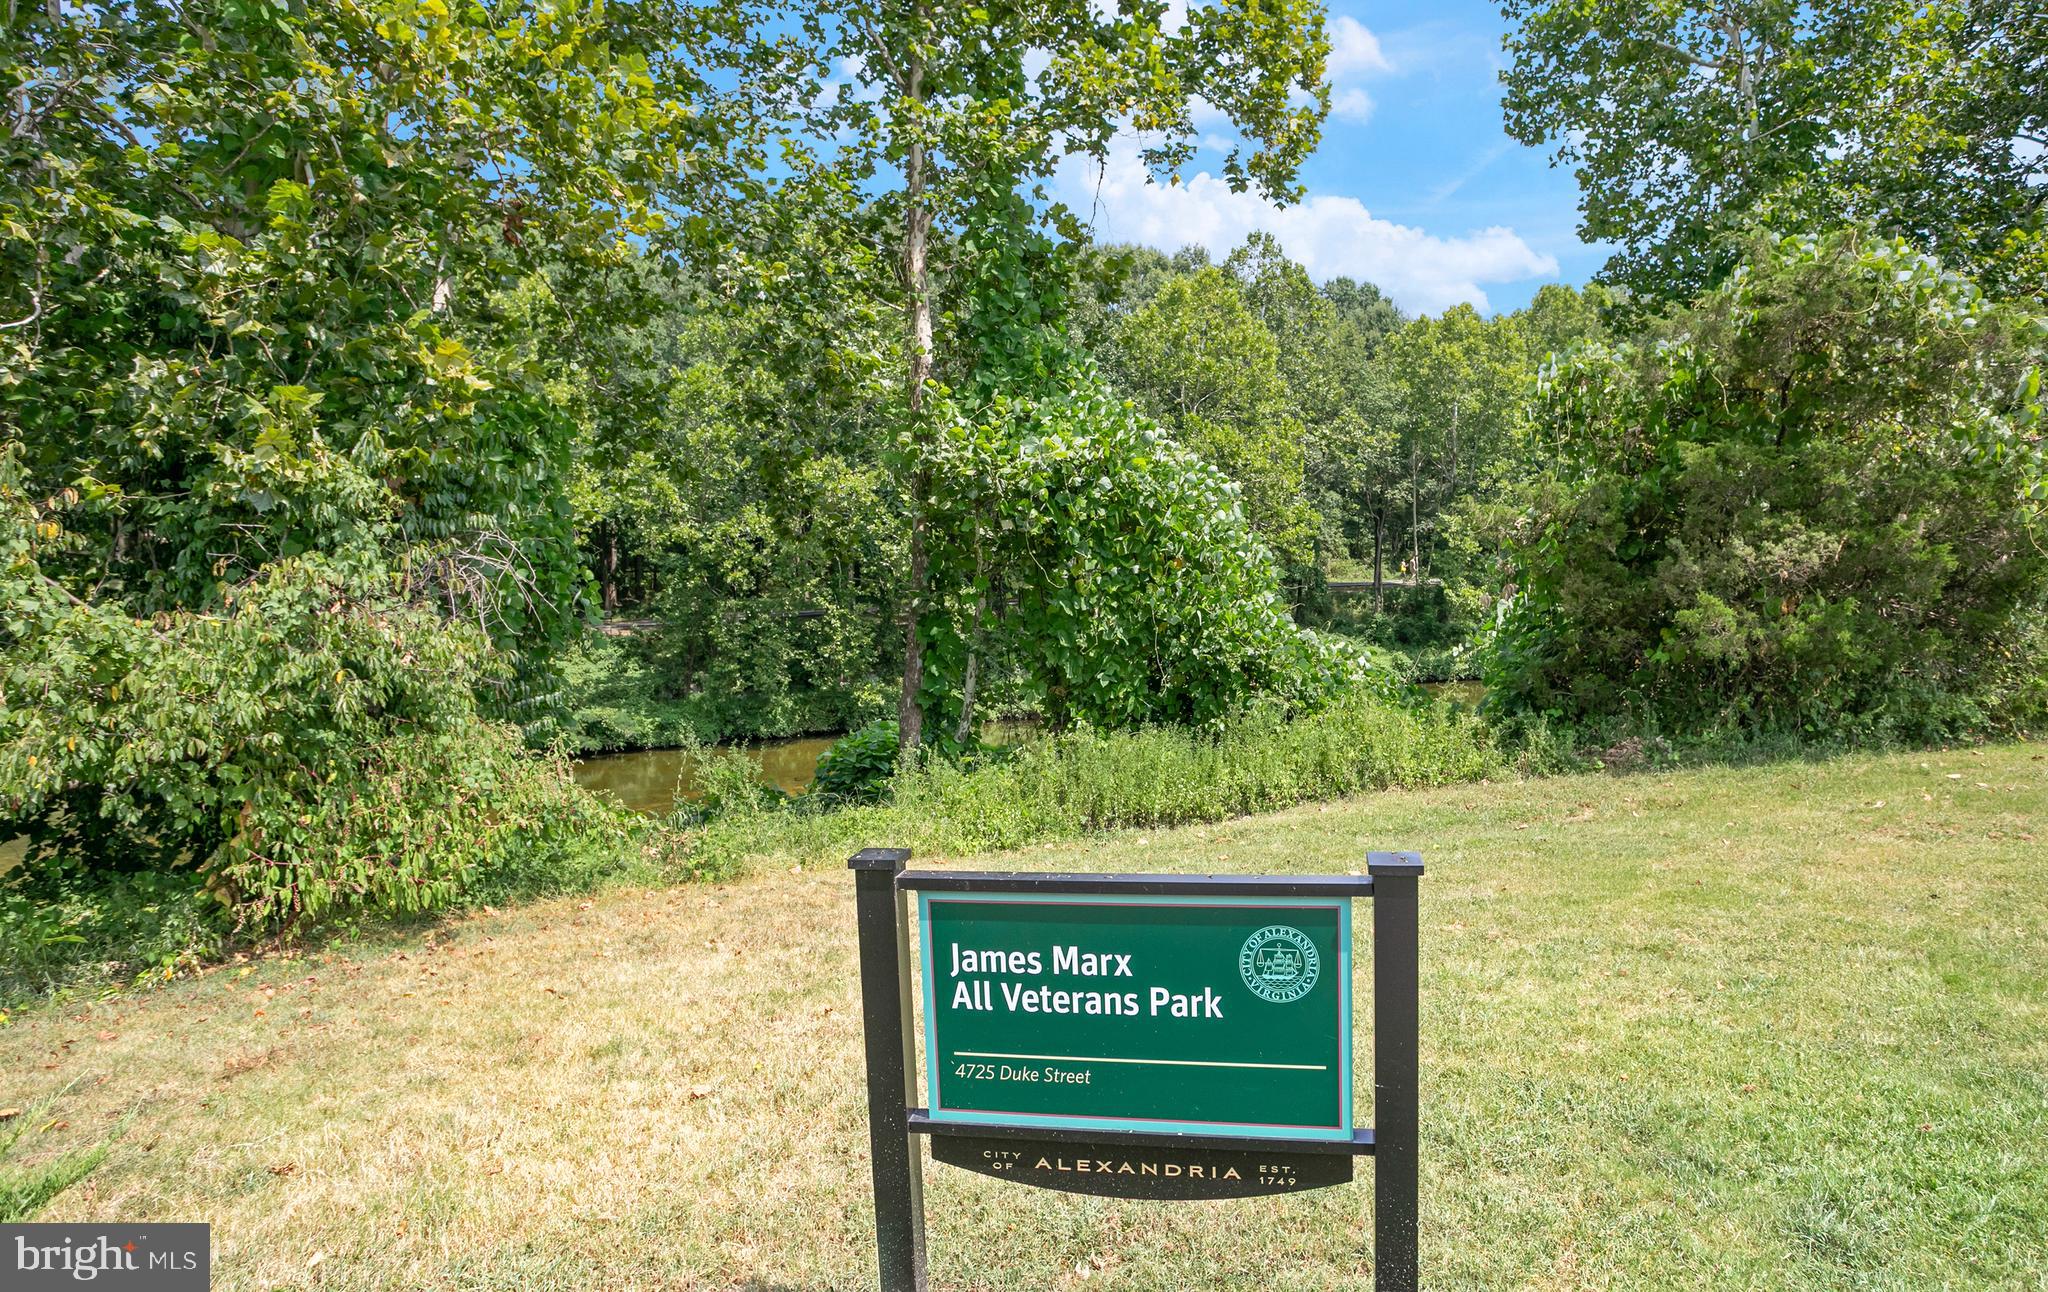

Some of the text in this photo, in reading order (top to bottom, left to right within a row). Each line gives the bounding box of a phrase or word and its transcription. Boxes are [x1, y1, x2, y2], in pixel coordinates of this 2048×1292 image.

[950, 943, 1133, 978] James Marx
[951, 980, 1224, 1020] All Veterans Park
[1251, 980, 1310, 1000] VIRGINIA
[955, 1064, 1091, 1085] 4725 Duke Street
[983, 1150, 1021, 1161] CITY
[993, 1162, 1013, 1170] OF
[1034, 1157, 1242, 1181] ALEXANDRIA
[1259, 1165, 1296, 1174] EST.
[1259, 1177, 1297, 1186] 1749
